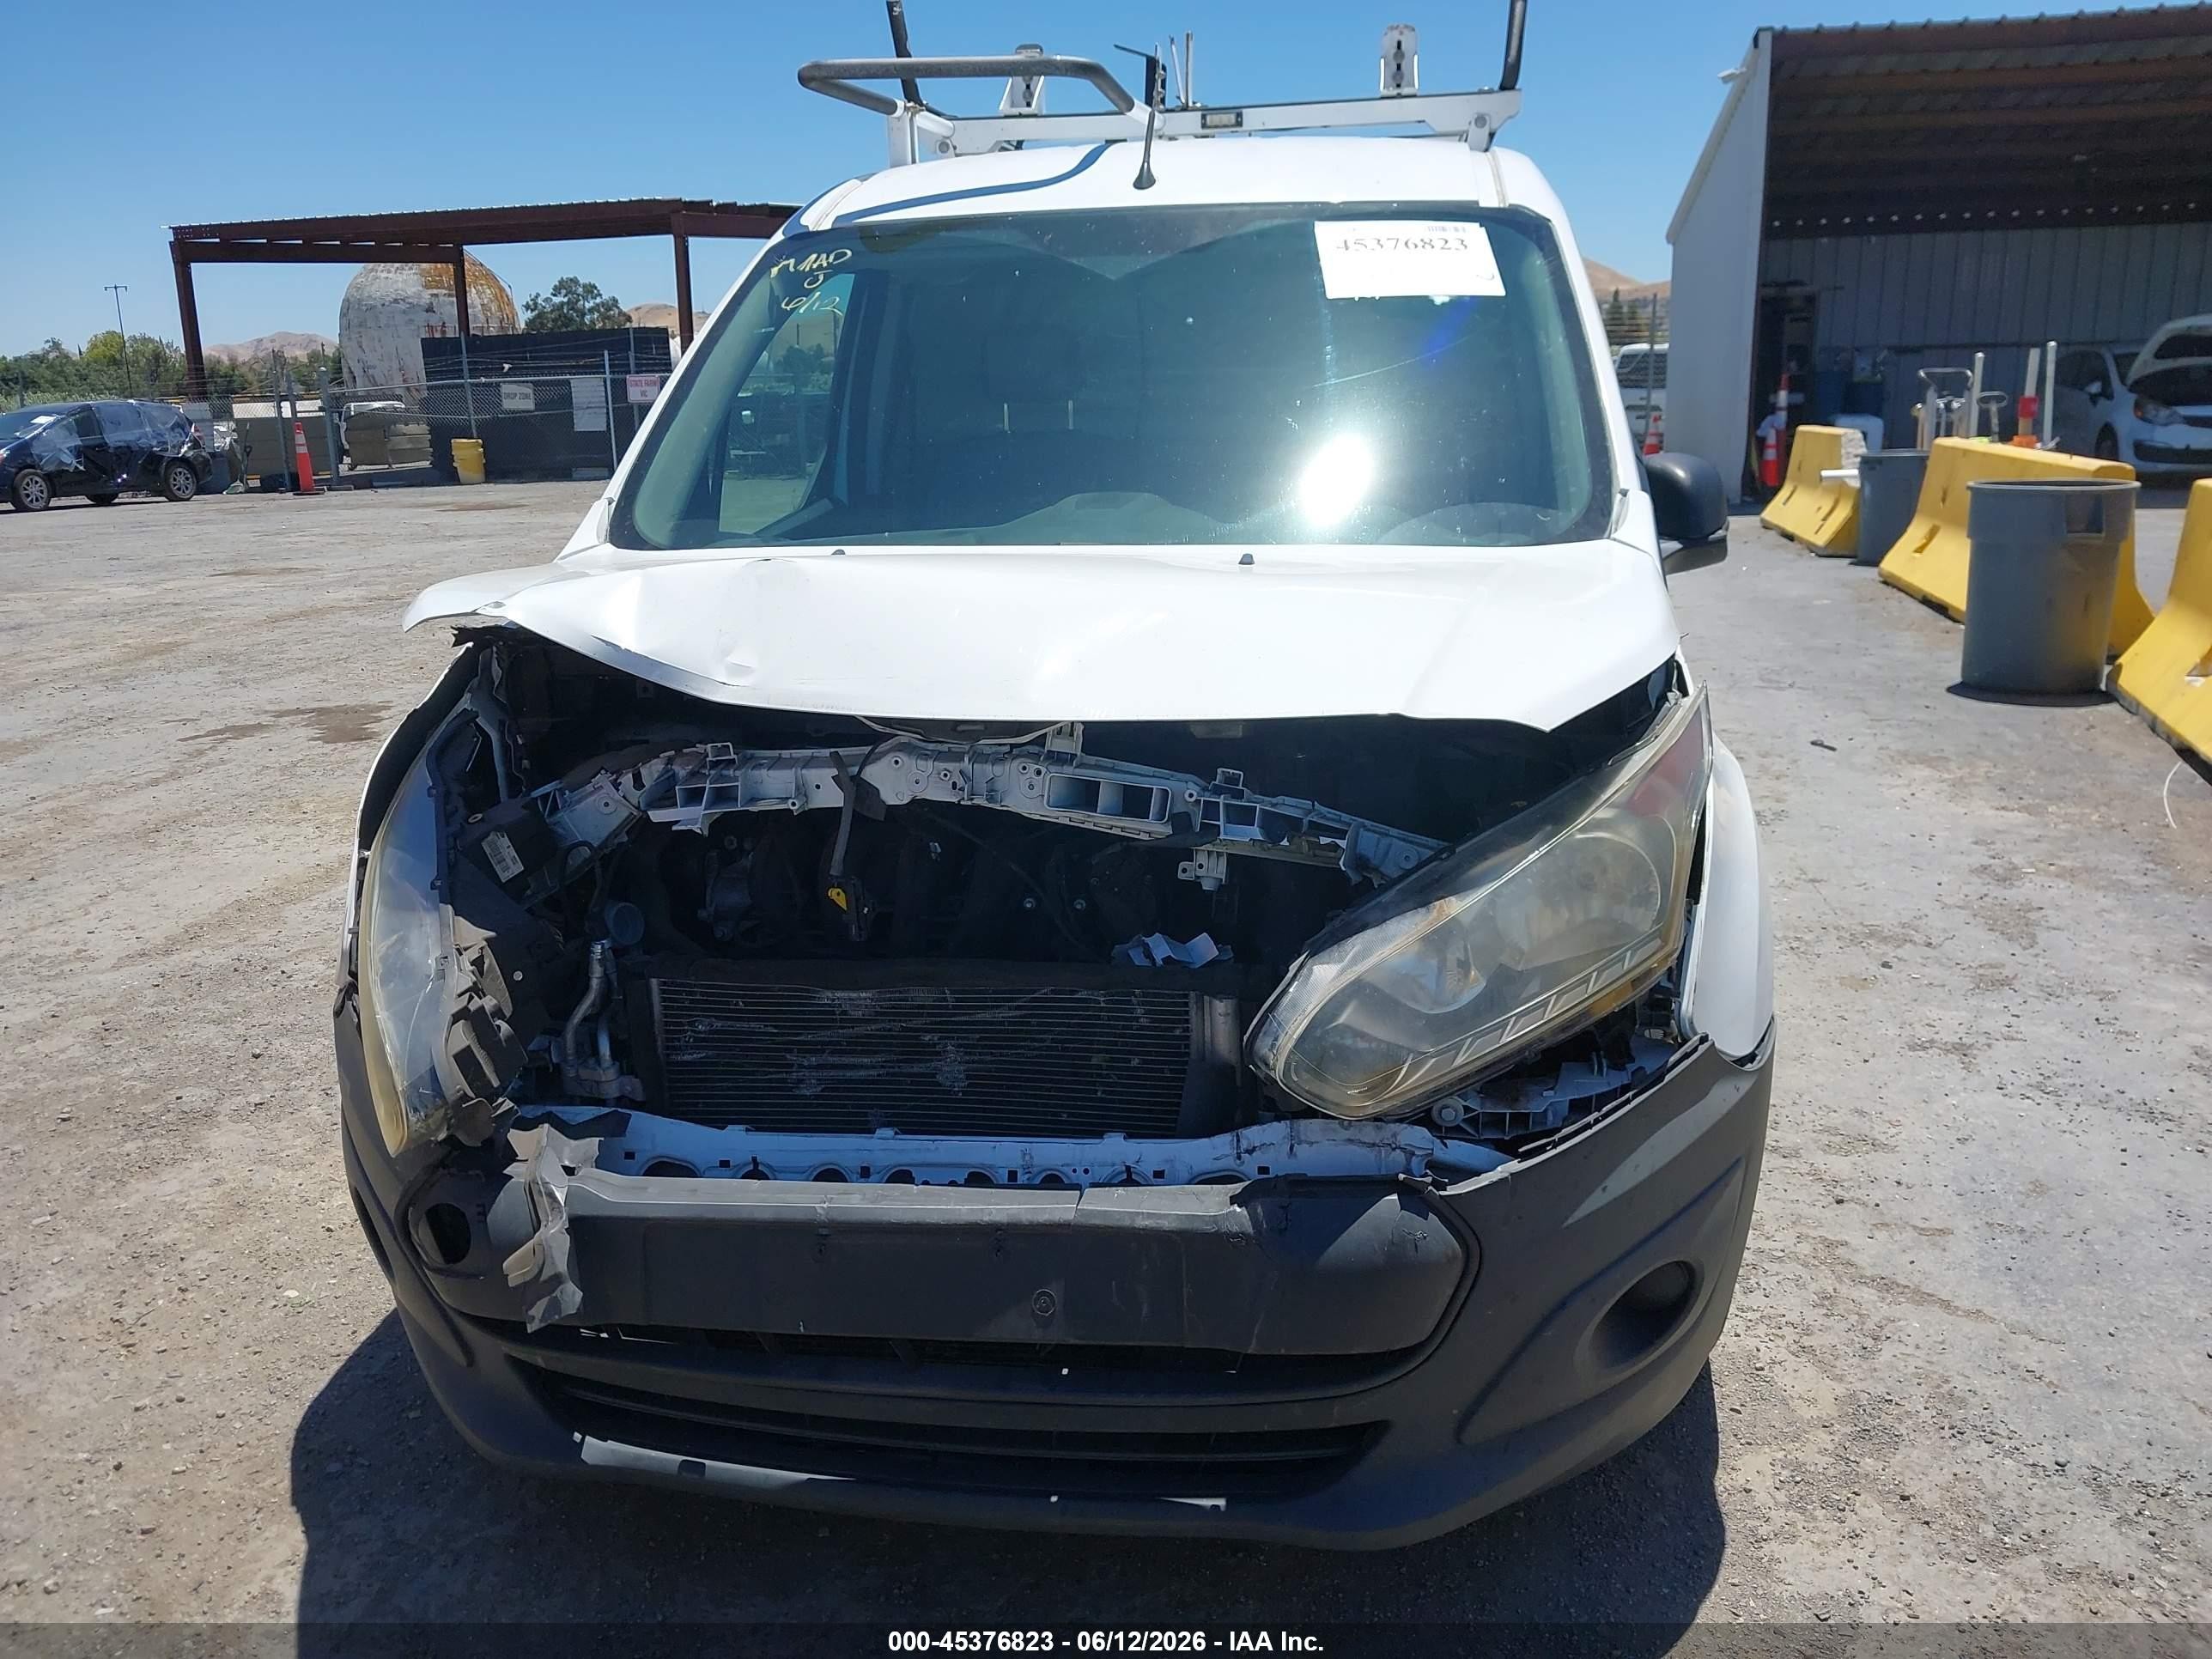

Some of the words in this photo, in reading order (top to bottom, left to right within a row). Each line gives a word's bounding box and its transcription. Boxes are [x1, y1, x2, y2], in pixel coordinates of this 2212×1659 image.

[1335, 237, 1469, 252] 45376823
[503, 392, 517, 400] DROP
[518, 392, 532, 400] ZONE
